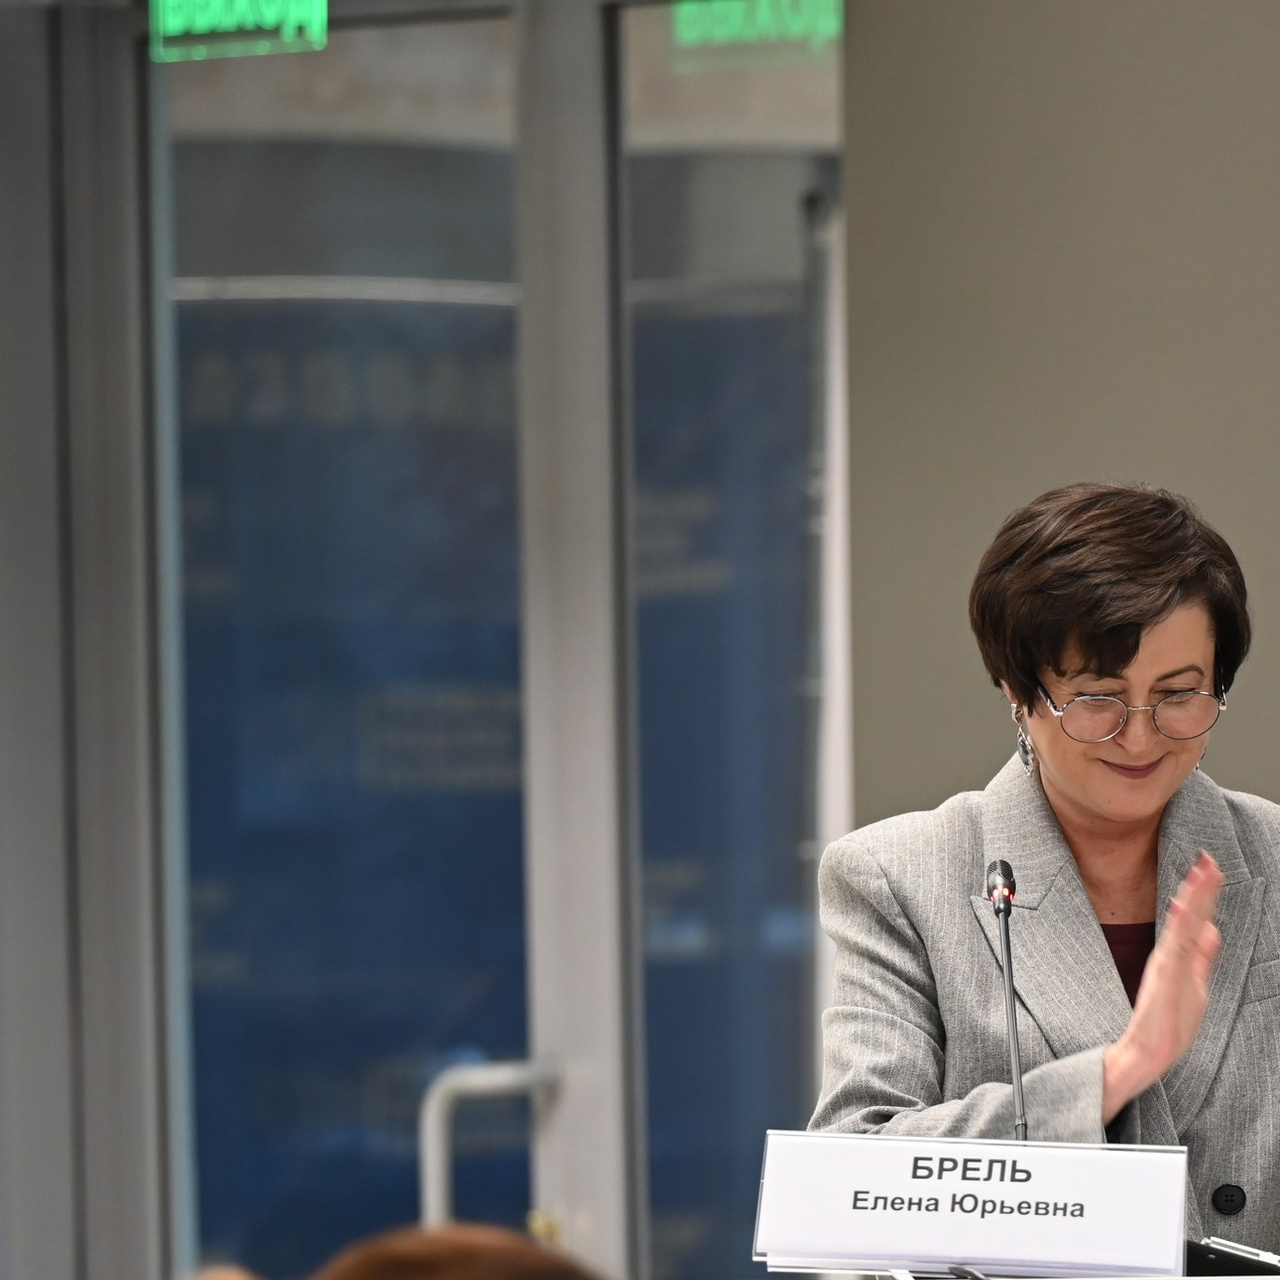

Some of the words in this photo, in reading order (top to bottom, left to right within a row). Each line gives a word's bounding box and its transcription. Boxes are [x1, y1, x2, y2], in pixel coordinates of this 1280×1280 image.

[911, 1156, 1033, 1183] БРЕЛЬ
[852, 1190, 940, 1212] Елена
[950, 1193, 1085, 1218] Юрьевна
